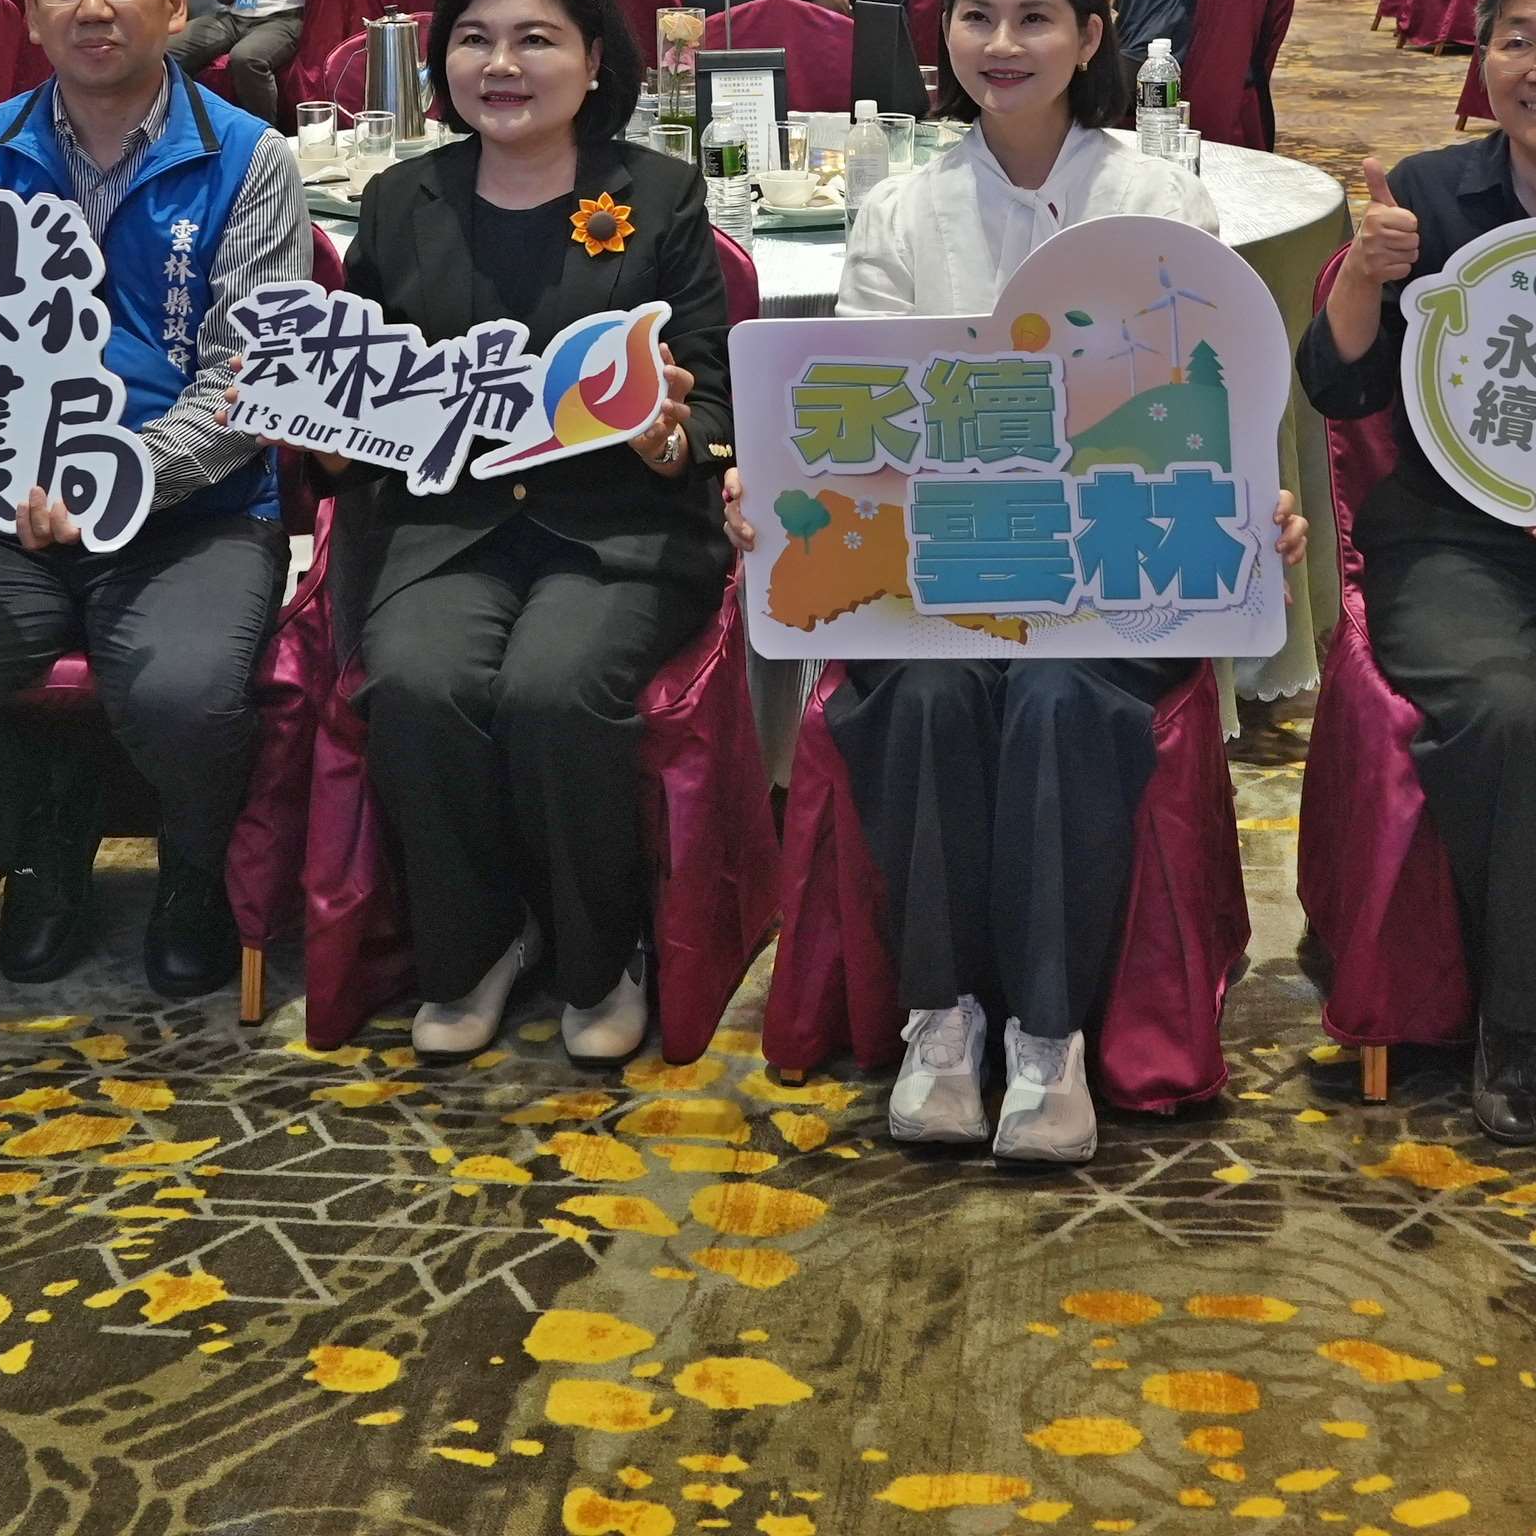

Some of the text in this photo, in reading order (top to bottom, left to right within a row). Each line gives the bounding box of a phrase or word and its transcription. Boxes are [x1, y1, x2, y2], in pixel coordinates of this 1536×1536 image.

[162, 218, 200, 375] 雲林縣政府
[231, 401, 415, 463] It's Our Time
[790, 358, 1061, 465] 永續
[909, 468, 1247, 605] 雲林
